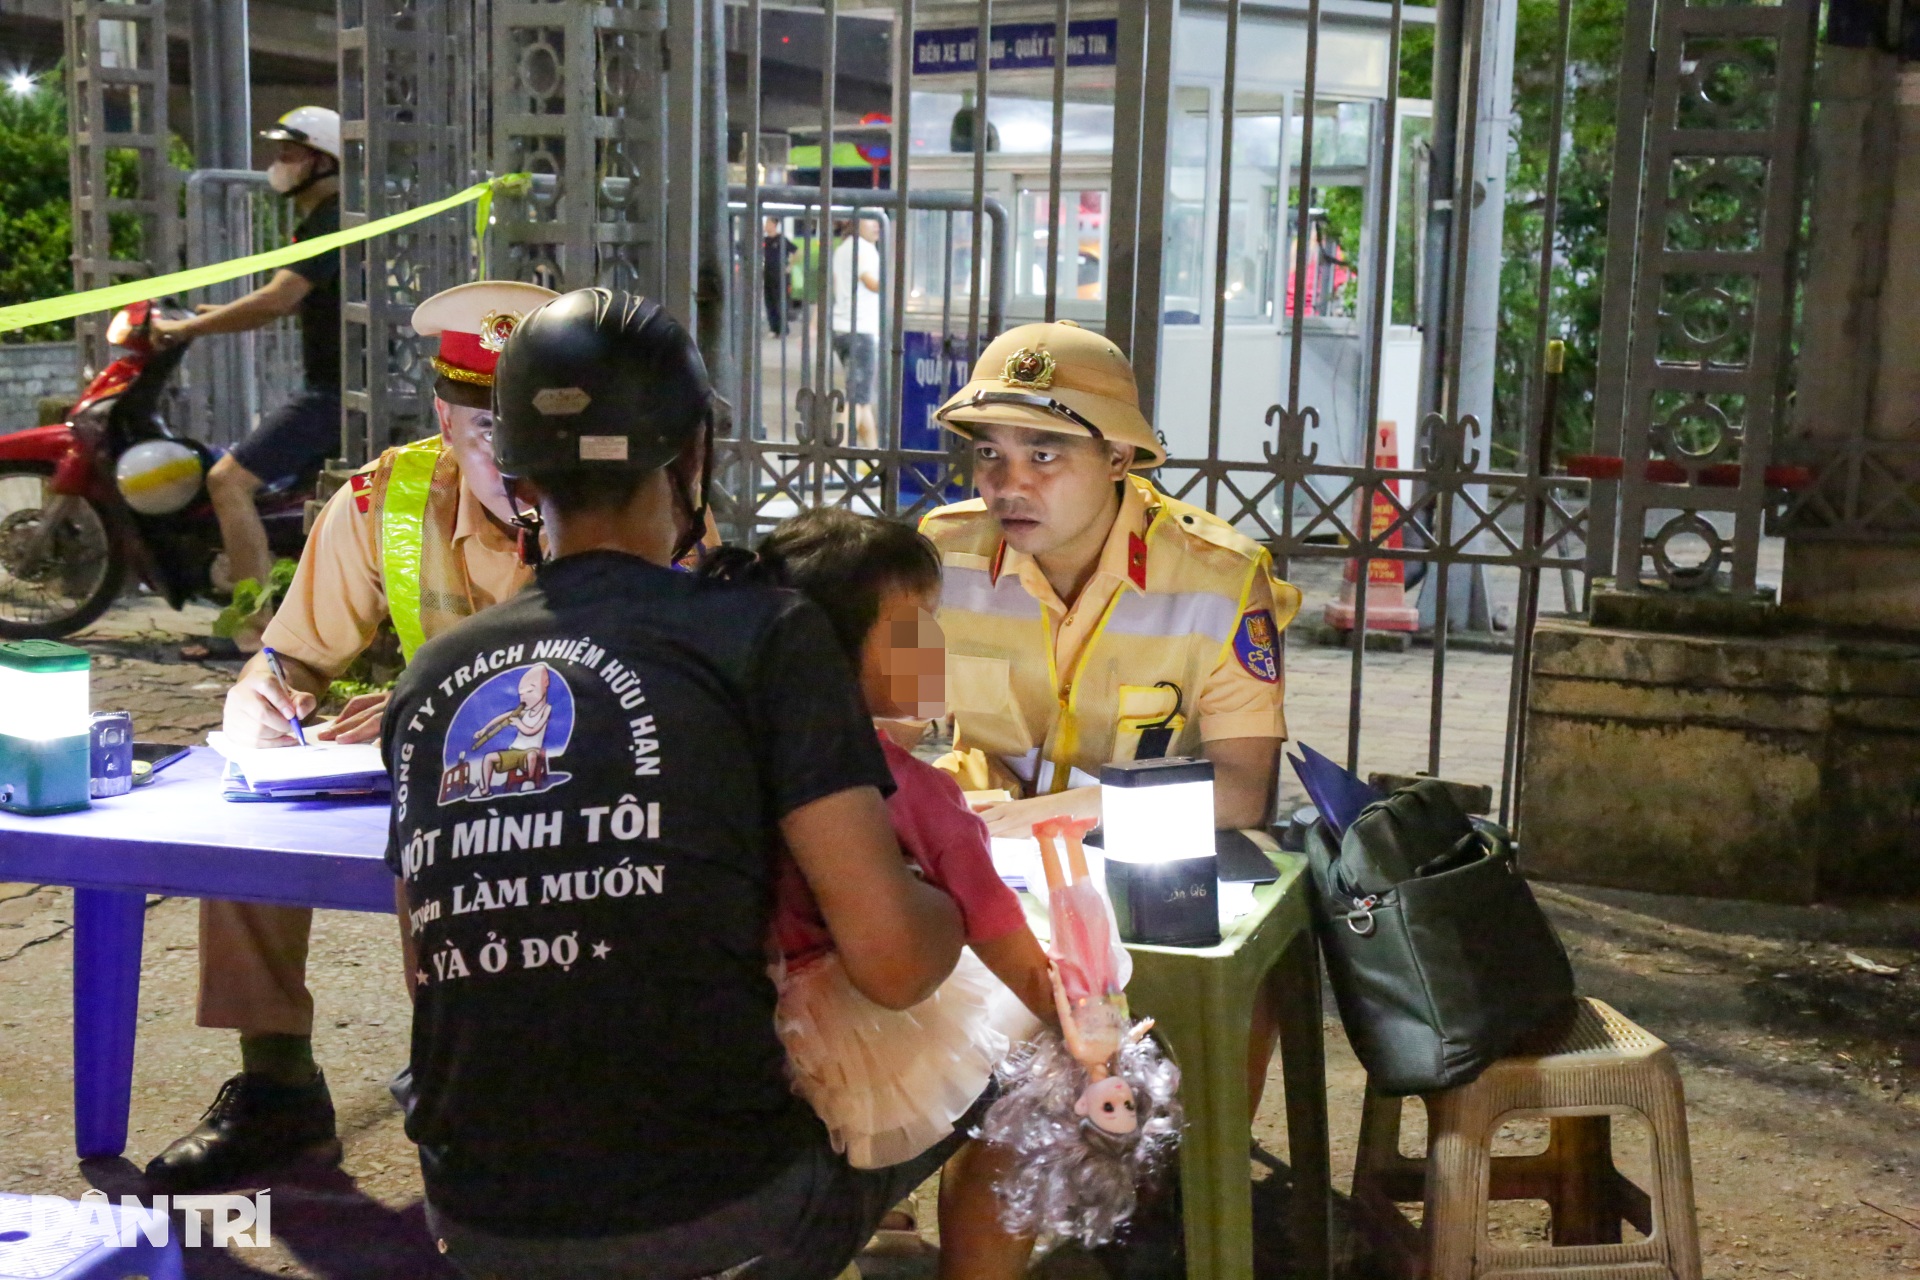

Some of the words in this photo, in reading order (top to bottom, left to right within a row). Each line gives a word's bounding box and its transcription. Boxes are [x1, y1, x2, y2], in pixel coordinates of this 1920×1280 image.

[407, 697, 436, 733] TY
[438, 644, 525, 698] TRÁCH
[531, 636, 607, 669] NHIỆM
[599, 659, 646, 711] HỮU
[629, 714, 661, 776] HẠN
[451, 807, 564, 860] MÌNH
[580, 793, 660, 843] TÔI
[452, 872, 529, 916] LÀM
[540, 856, 666, 905] MƯỚN
[433, 939, 471, 982] VÀ
[479, 931, 508, 974] Ở
[520, 930, 579, 972] ĐỢ
